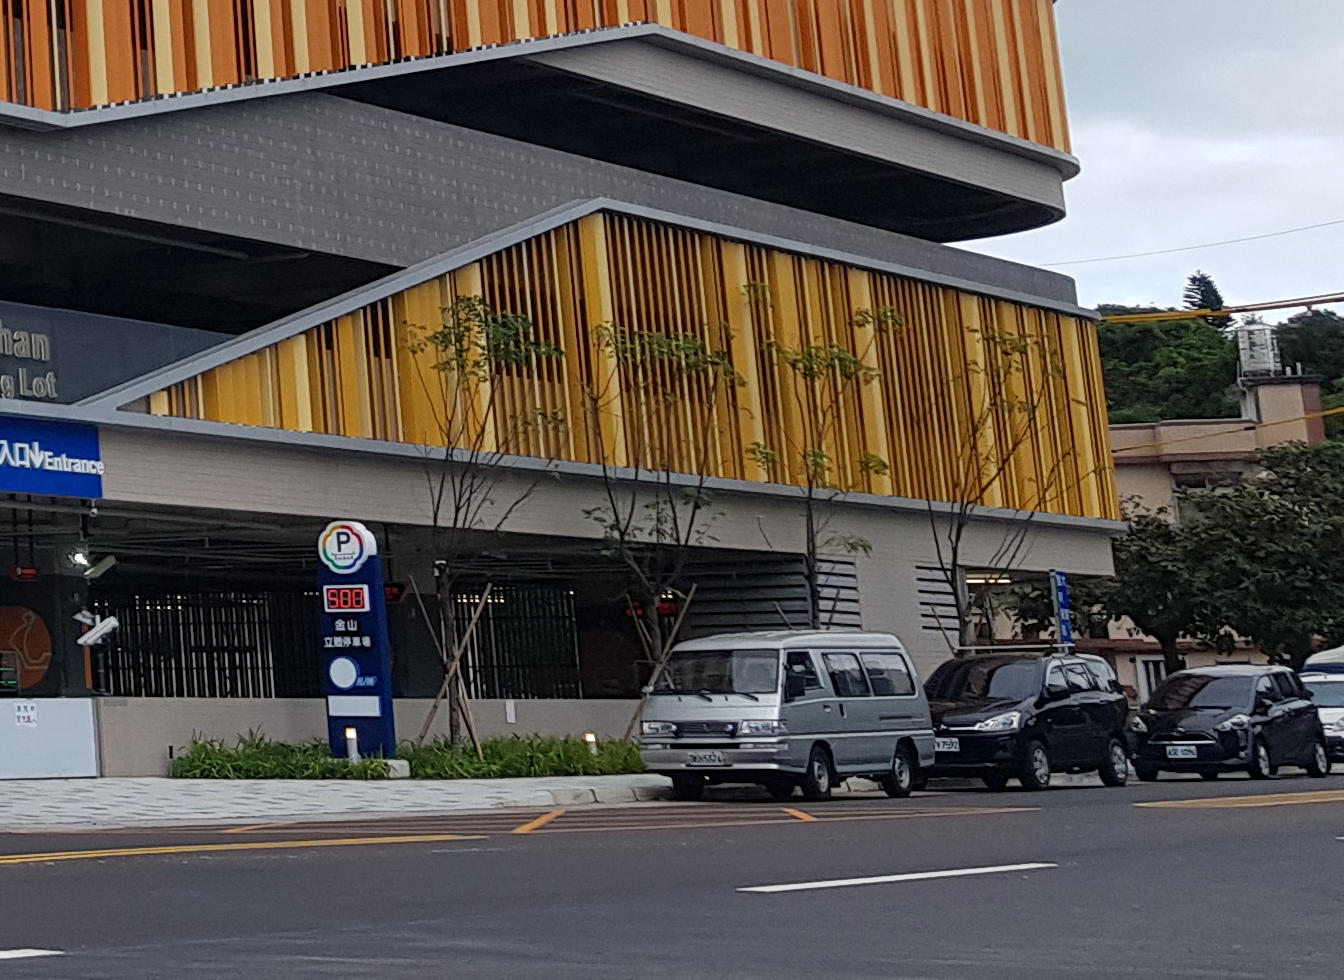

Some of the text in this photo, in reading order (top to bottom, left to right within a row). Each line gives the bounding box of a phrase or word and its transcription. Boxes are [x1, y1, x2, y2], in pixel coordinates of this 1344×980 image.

[19, 367, 58, 399] Lot
[43, 451, 105, 475] Entrance
[336, 531, 351, 553] P
[327, 589, 364, 609] 500
[334, 619, 358, 631] 金山
